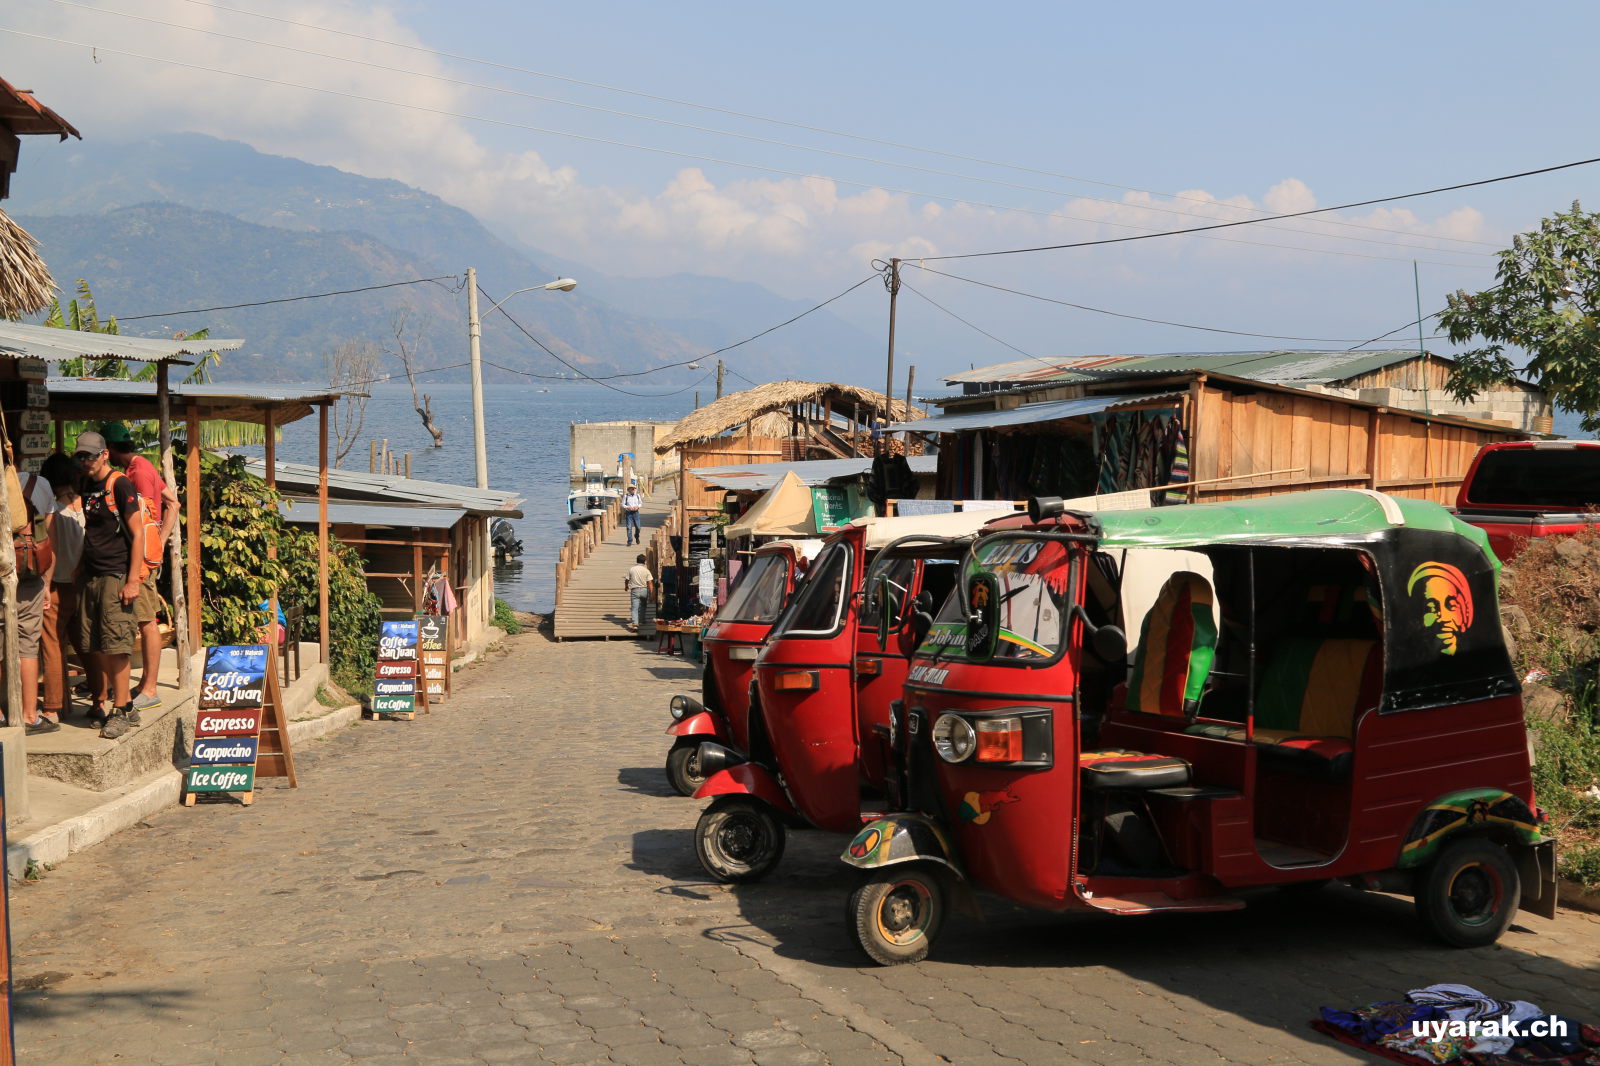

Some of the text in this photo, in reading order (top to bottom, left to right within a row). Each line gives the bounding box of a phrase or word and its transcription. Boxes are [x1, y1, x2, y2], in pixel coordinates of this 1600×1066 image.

[980, 542, 1046, 565] ELVIS
[380, 637, 408, 648] Coffee
[422, 638, 442, 650] offee
[380, 665, 412, 676] Espresso
[207, 672, 251, 688] Coffee
[377, 681, 413, 693] Cappuccino
[376, 699, 411, 711] Ice Coffee
[200, 717, 255, 733] Espresso
[194, 743, 251, 762] Cappuccino
[191, 771, 248, 789] Ice Coffee
